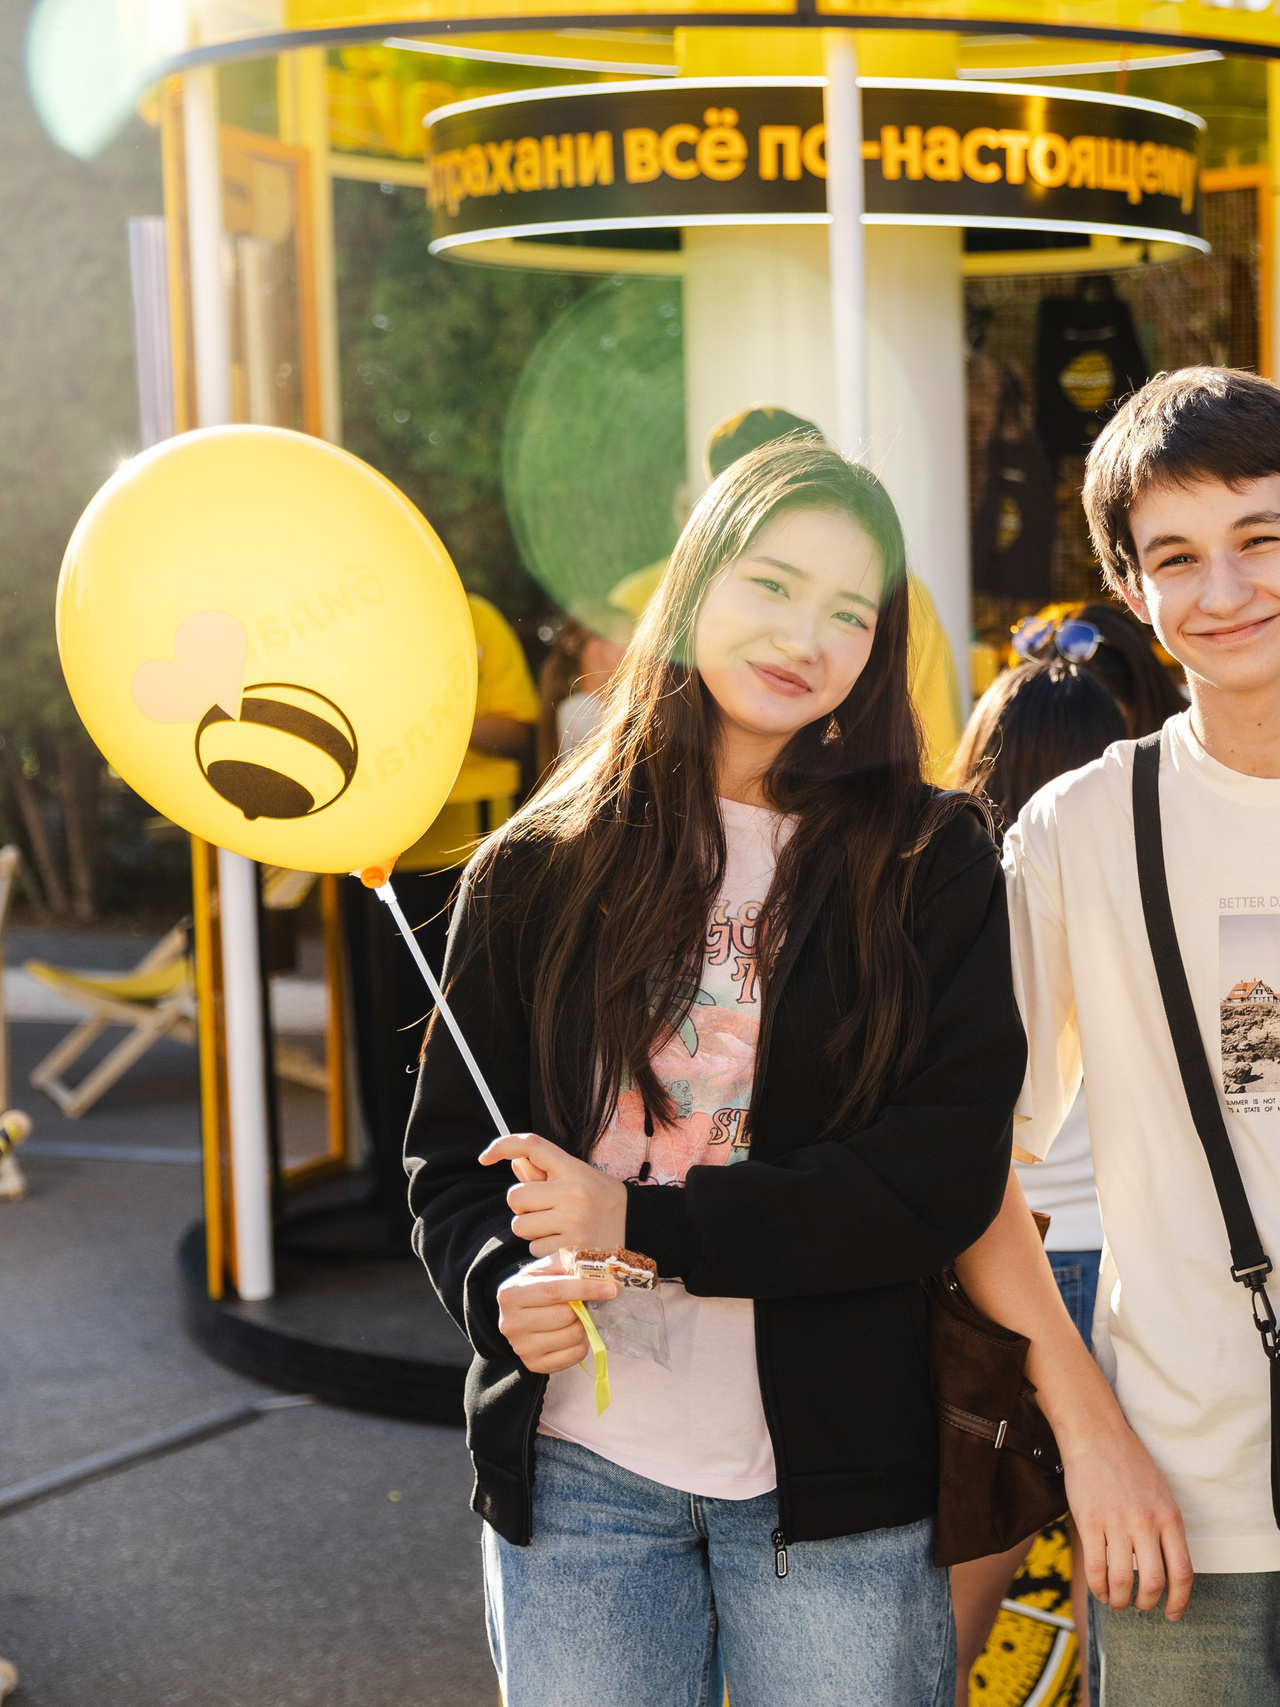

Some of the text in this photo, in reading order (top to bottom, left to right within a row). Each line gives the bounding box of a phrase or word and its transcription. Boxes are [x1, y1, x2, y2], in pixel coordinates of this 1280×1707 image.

[427, 130, 614, 217] трахани
[623, 107, 748, 184] всё
[1219, 897, 1265, 909] BETTER
